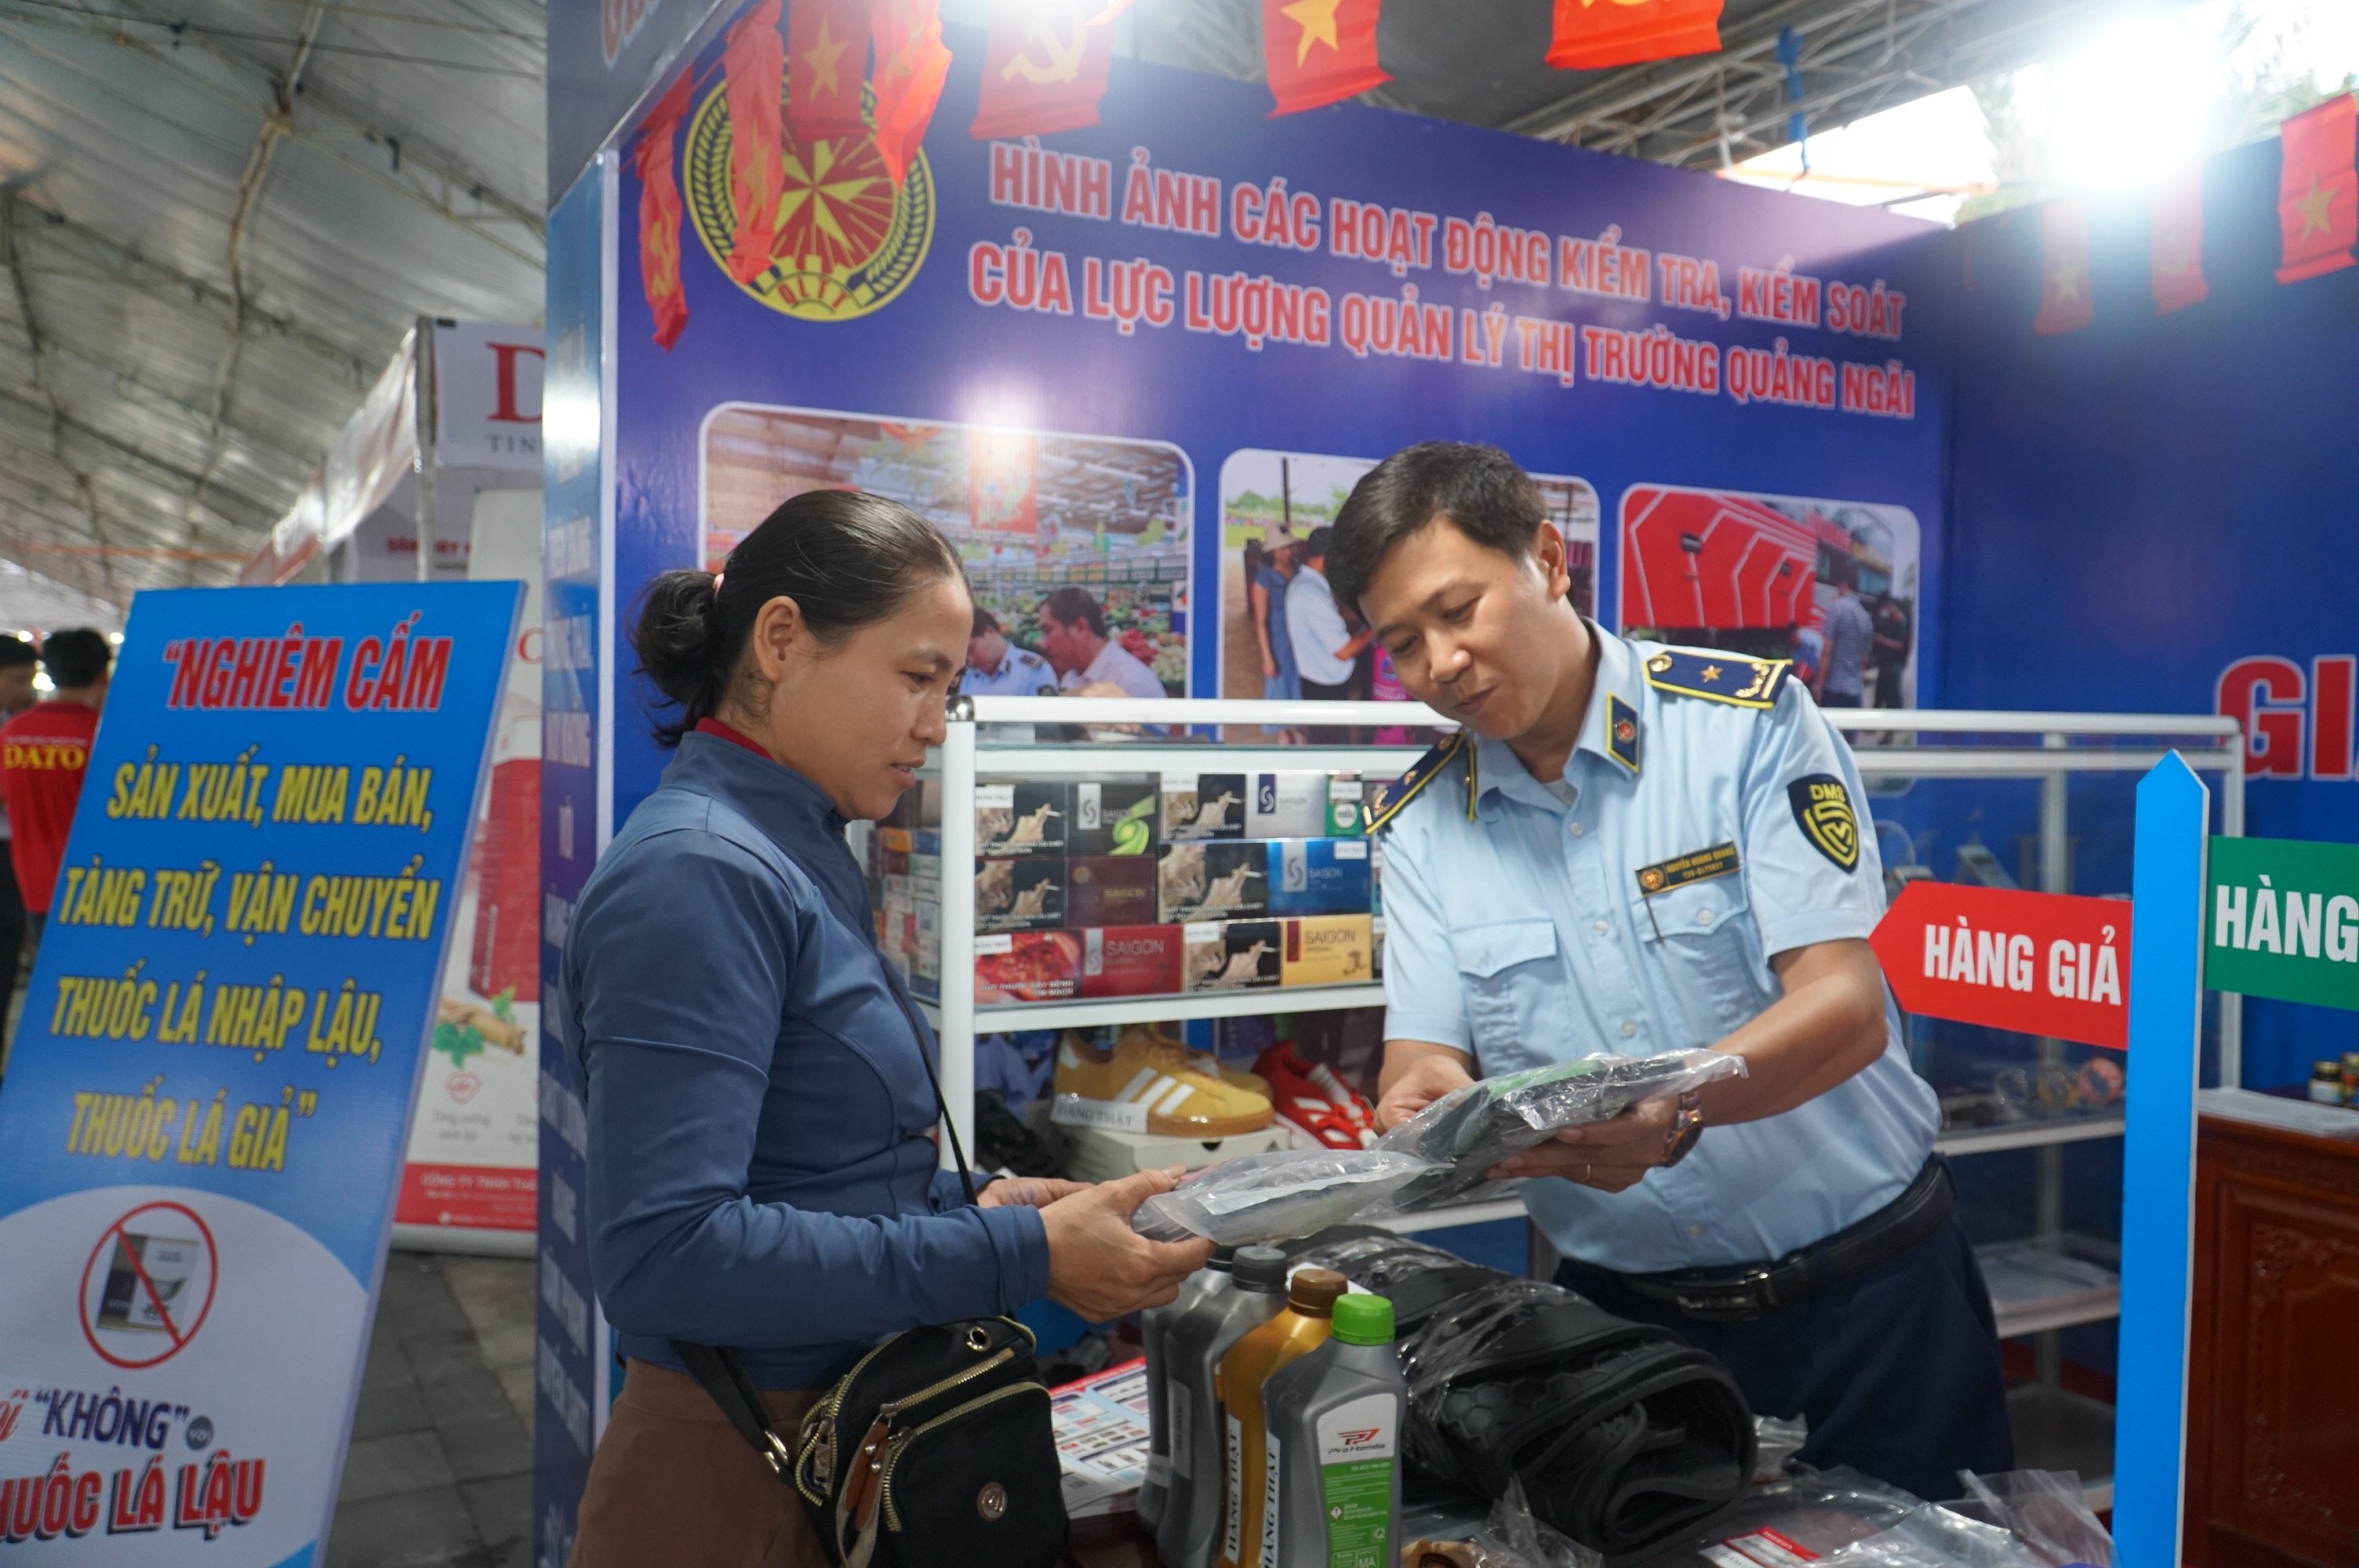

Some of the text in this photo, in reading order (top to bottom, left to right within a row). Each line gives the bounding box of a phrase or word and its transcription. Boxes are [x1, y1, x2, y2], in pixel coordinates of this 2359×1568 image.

[990, 136, 1906, 341] HÌNH ẢNH CÁC HOẠT ĐỘNG KIỂM TRA, KIỂM SOÁT
[968, 227, 1914, 419] CỦA LỰC LƯỢNG QUẢN LÝ THỊ TRƯỜNG QUẢNG NGÃI
[343, 611, 453, 711] CẤM
[4, 744, 85, 770] DATO
[107, 745, 432, 834] SẢN XUẤT, MUA BÁN,
[1809, 784, 1847, 803] DMS
[58, 855, 441, 947] TÀNG TRỮ, VẬN CHUYỂN
[1305, 928, 1357, 946] SAIGON
[2215, 873, 2359, 964] HÀNG
[1105, 938, 1165, 956] SAIGON
[1923, 915, 2121, 1005] HÀNG GIẢ
[50, 959, 382, 1066] THUỐC LÁ NHẬP LẬU,
[67, 1075, 176, 1160] THUỐC
[176, 1088, 228, 1166] LÁ
[107, 1454, 165, 1535] LÁ
[173, 1449, 265, 1541] LẬU
